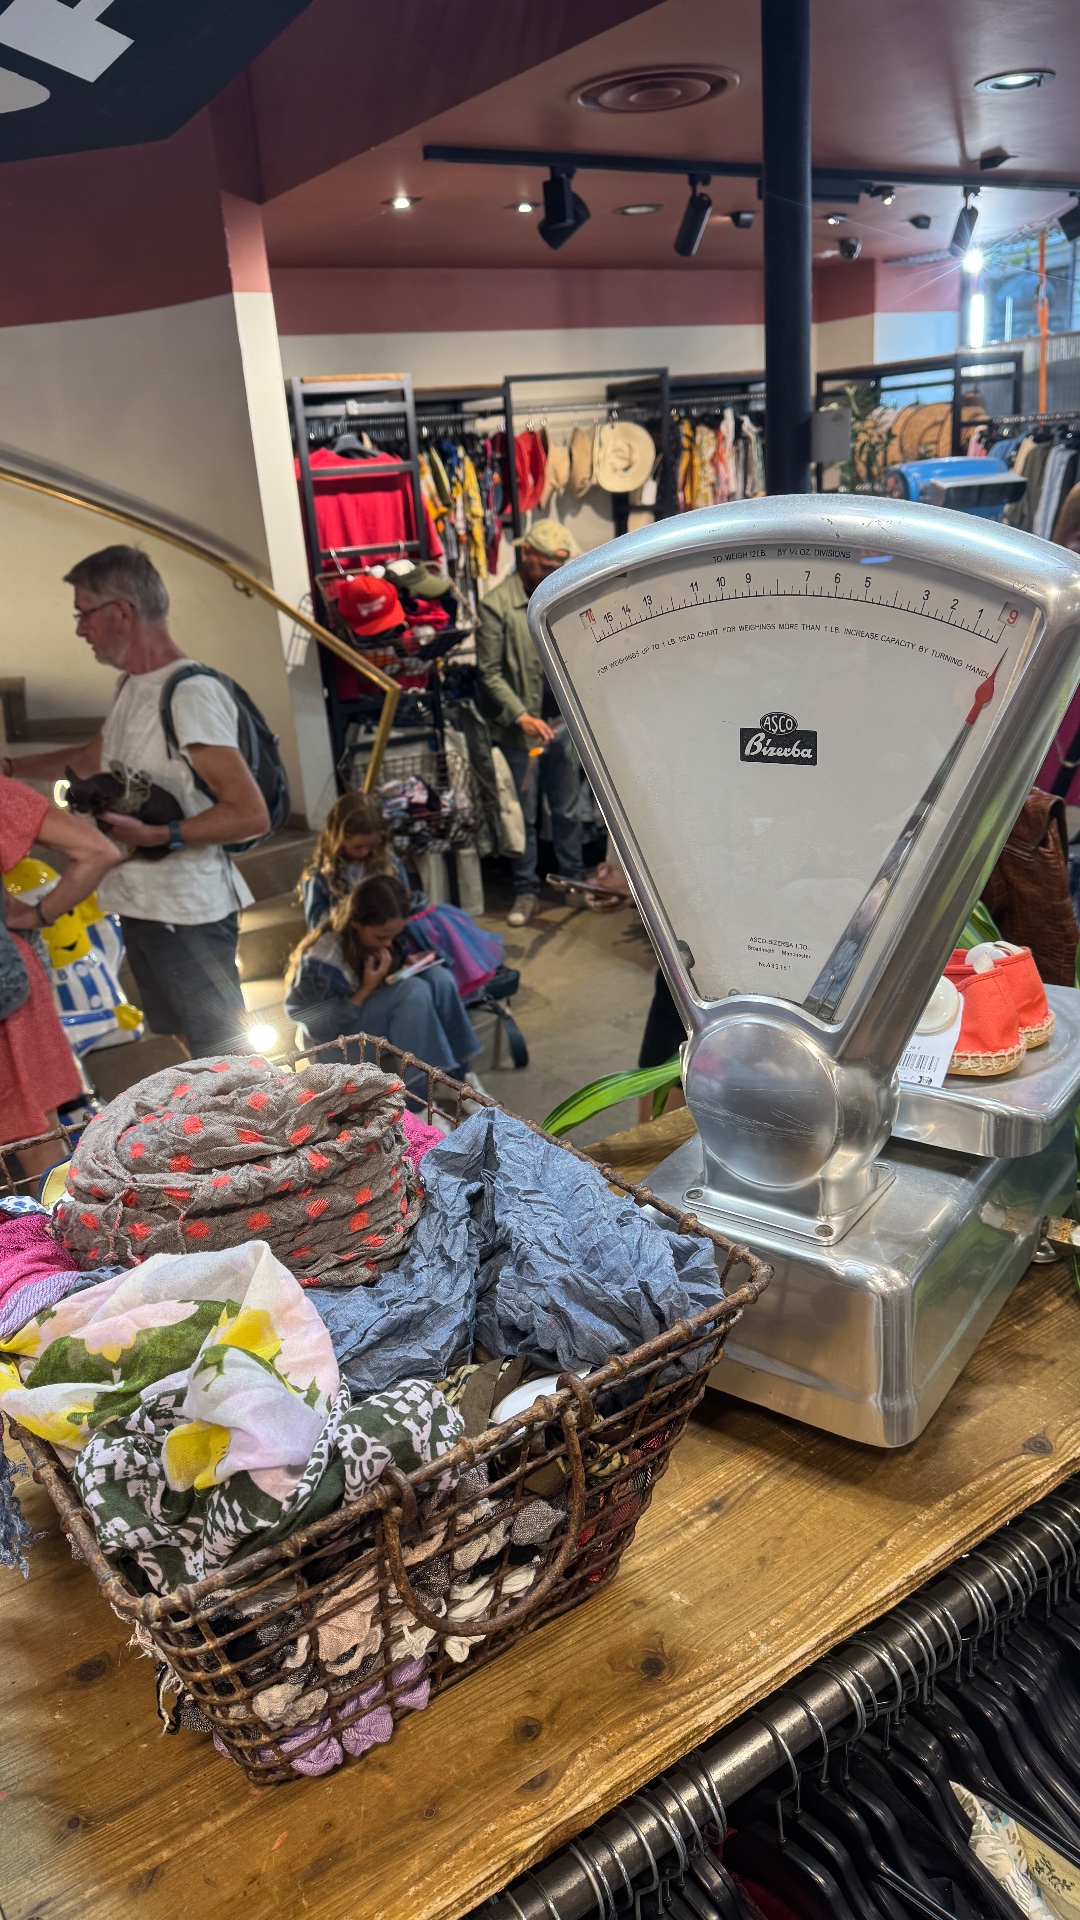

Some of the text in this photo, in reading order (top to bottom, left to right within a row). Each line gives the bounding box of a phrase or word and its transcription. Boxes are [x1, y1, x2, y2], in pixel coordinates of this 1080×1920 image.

[712, 555, 723, 563] TO
[725, 551, 748, 561] WEIGH
[777, 548, 787, 556] BY
[814, 548, 851, 559] DIVISIONS
[603, 611, 614, 623] 15
[621, 603, 631, 615] 14
[642, 595, 653, 606] 13
[689, 581, 699, 592] 11
[716, 576, 726, 587] 10
[745, 573, 752, 583] 9
[805, 571, 811, 581] 7
[834, 573, 841, 583] 6
[864, 576, 872, 588] 5
[922, 589, 931, 600] 3
[950, 598, 959, 610] 2
[978, 608, 984, 619] 1
[678, 633, 696, 642] READ
[722, 625, 736, 633] FOR
[738, 623, 776, 632] WEIGHINGS
[801, 623, 821, 631] THAN
[843, 627, 879, 641] INCREASE
[880, 634, 917, 649] CAPACITY
[918, 645, 929, 654] BY
[931, 649, 963, 667] TURNING
[763, 715, 794, 734] ASCO
[744, 732, 813, 758] Bizerba
